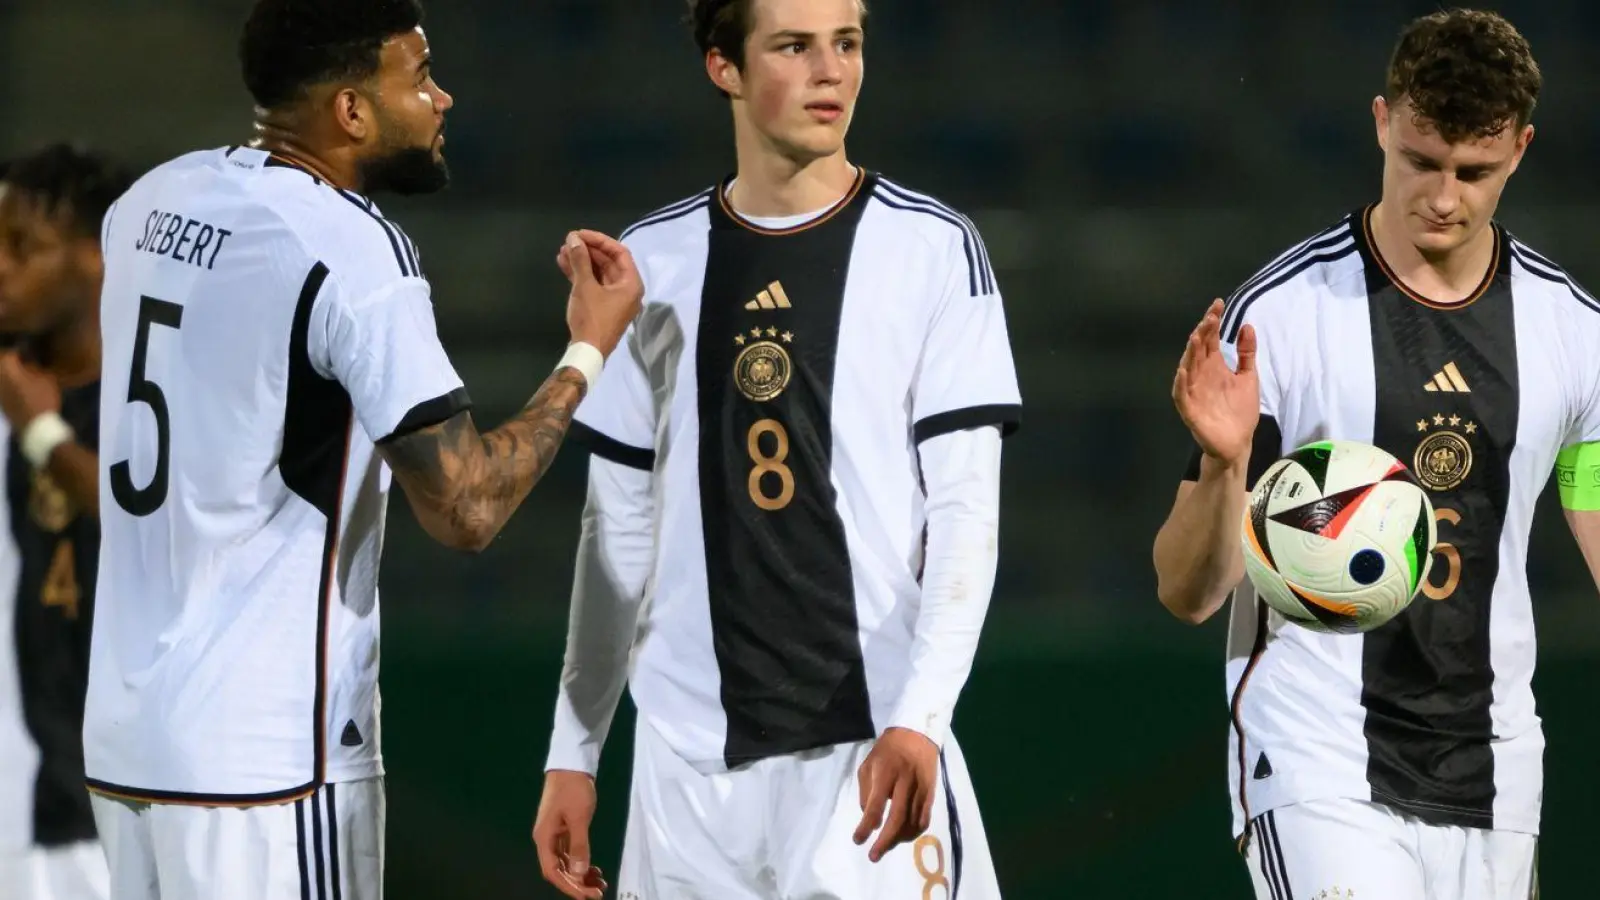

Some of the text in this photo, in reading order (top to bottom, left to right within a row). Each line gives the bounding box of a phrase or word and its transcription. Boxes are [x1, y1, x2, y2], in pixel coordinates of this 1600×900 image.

[136, 209, 232, 270] SIEBERT
[110, 294, 184, 516] 5
[747, 418, 795, 511] 8
[1557, 469, 1576, 484] ECT
[40, 541, 80, 619] 4
[1421, 508, 1461, 600] 6
[913, 834, 950, 900] 8
